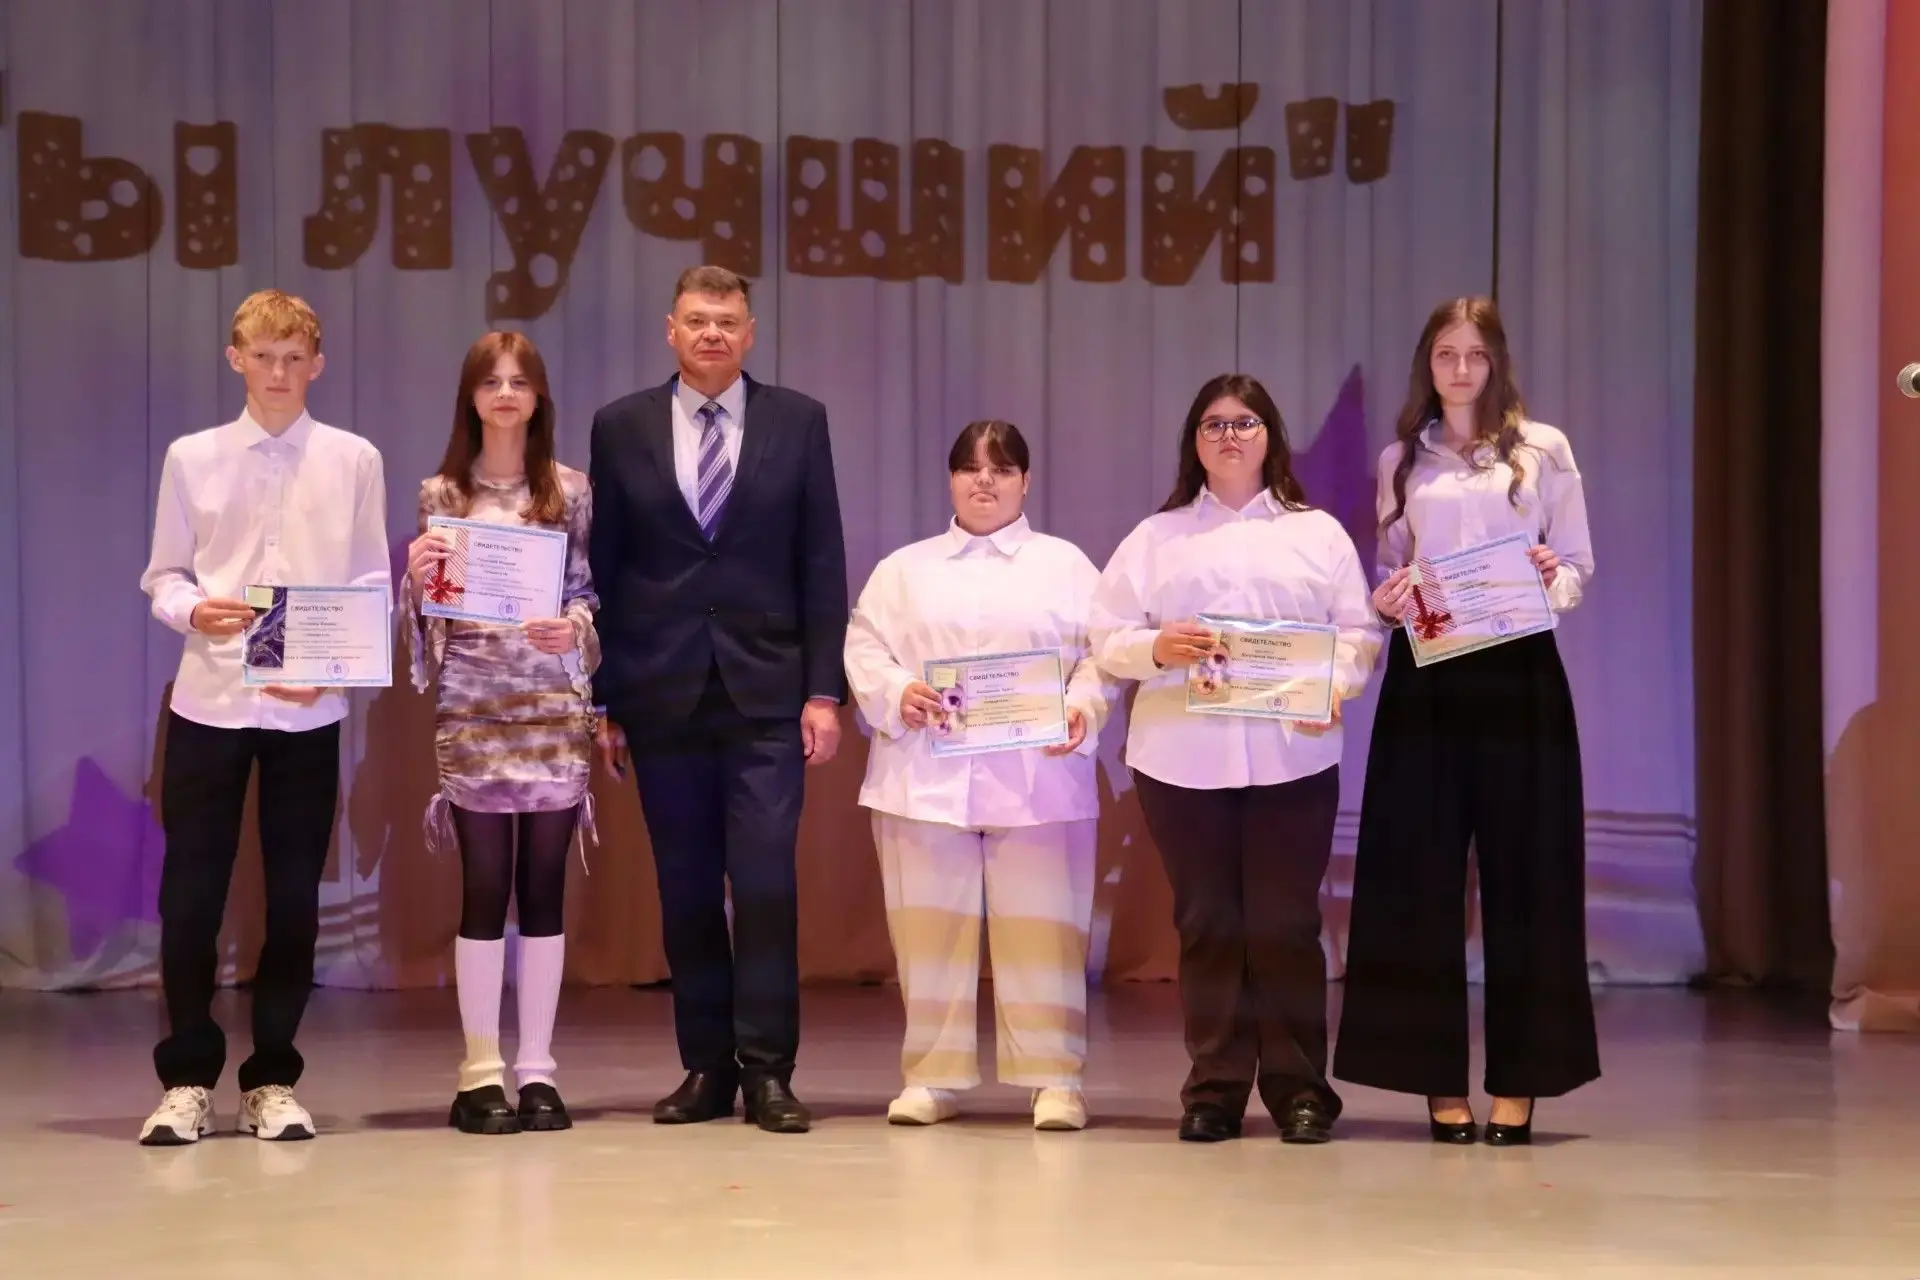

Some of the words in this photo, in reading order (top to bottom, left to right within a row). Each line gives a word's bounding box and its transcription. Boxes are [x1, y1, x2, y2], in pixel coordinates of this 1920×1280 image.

[0, 70, 163, 263] ы
[1239, 637, 1292, 648] СВИДЕТЕЛЬСТВО
[969, 672, 1020, 681] СВИДЕТЕЛЬСТВО
